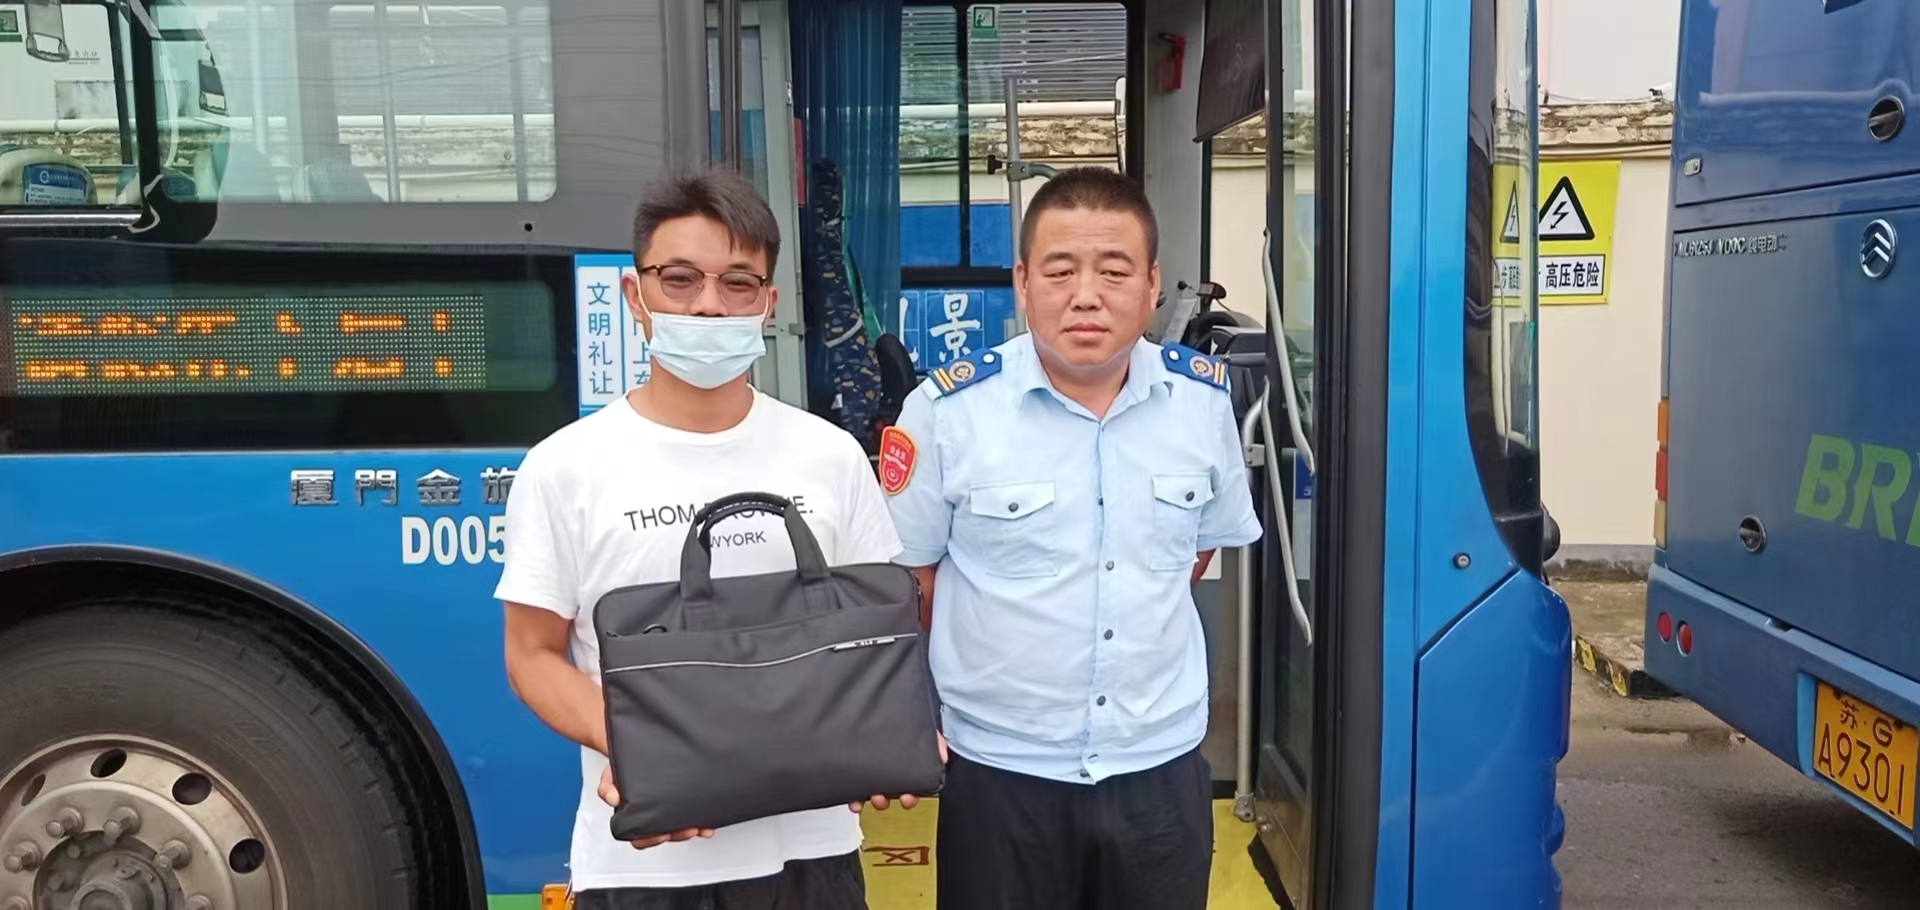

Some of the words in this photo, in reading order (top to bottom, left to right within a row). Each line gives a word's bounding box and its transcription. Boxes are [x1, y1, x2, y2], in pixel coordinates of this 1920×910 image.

[1545, 261, 1600, 289] 高压危险
[586, 281, 614, 395] 文明礼让
[1795, 433, 1920, 548] BR
[402, 515, 506, 566] D005
[624, 503, 696, 531] THOM
